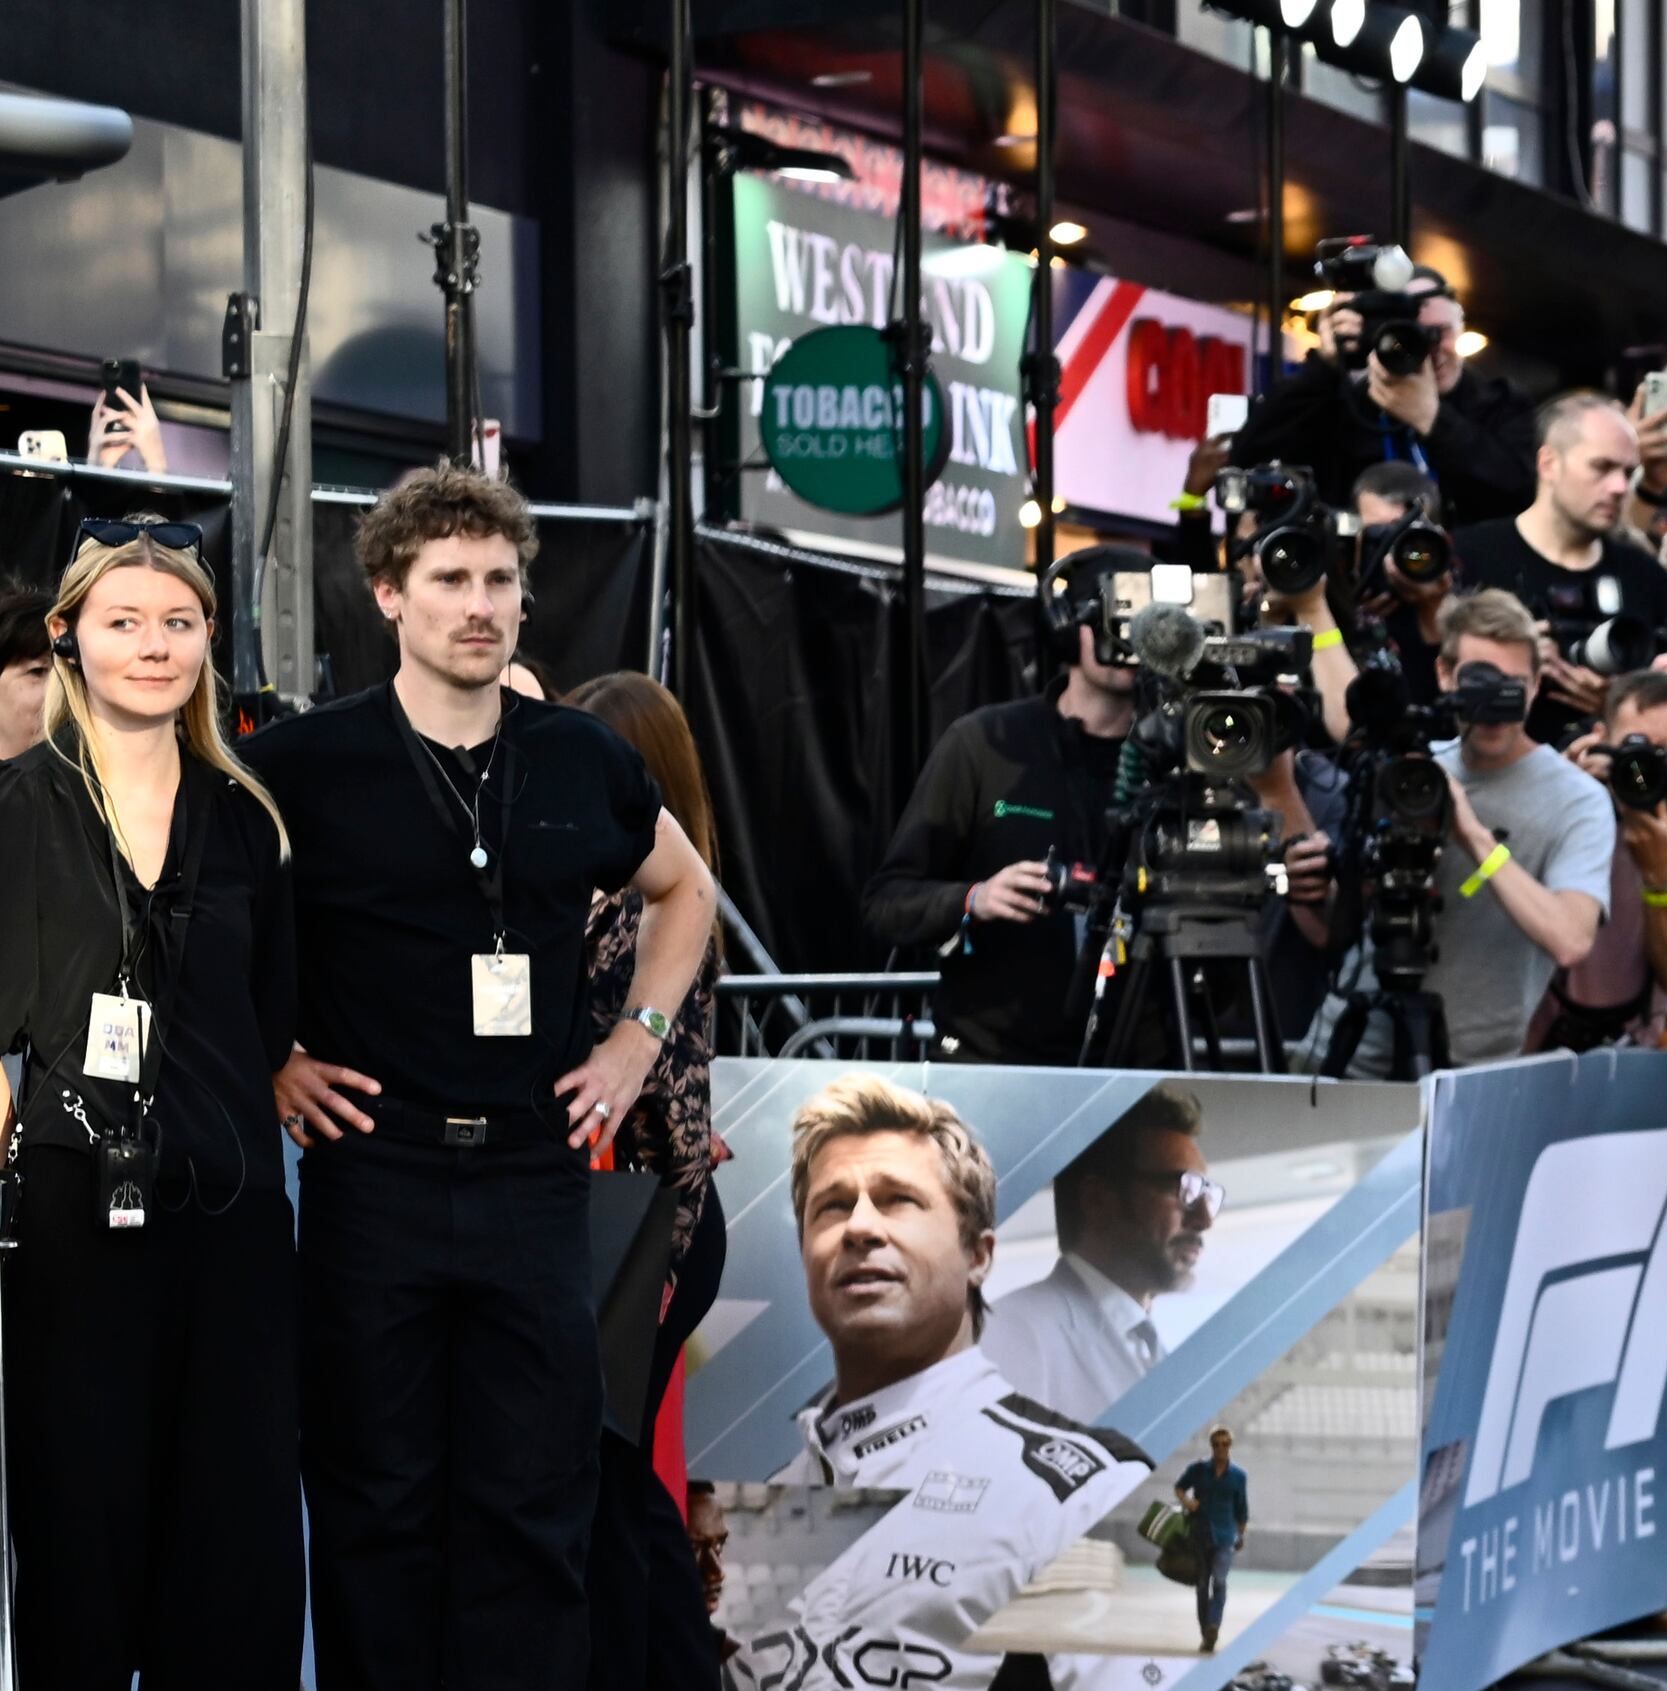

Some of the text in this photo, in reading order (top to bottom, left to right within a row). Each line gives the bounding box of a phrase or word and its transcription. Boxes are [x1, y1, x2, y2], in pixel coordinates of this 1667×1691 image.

[767, 220, 995, 364] WEST ND
[776, 432, 848, 459] SOLD
[950, 381, 1017, 475] INK
[886, 1553, 956, 1588] IWC
[1460, 1467, 1657, 1613] THE MOVIE
